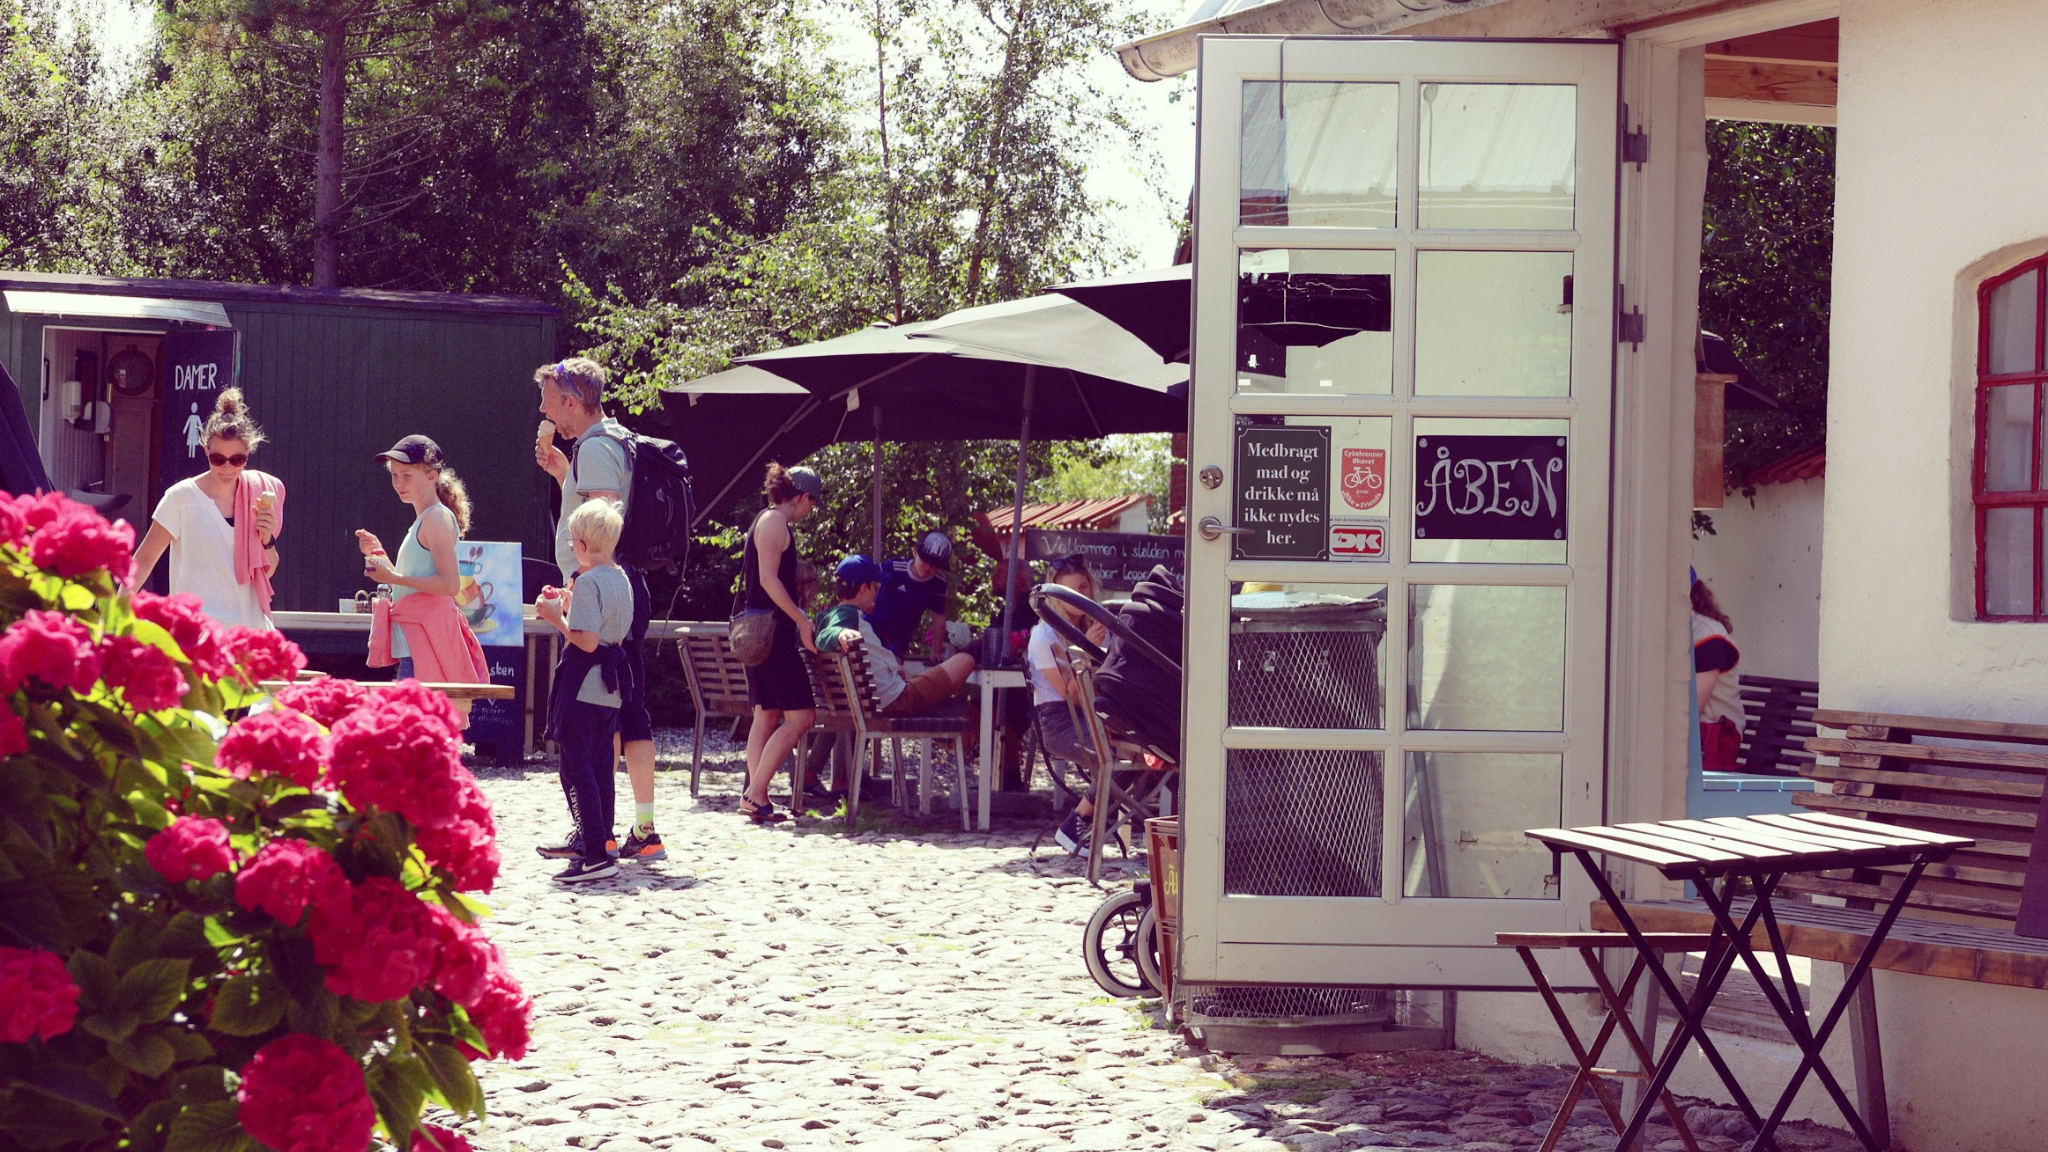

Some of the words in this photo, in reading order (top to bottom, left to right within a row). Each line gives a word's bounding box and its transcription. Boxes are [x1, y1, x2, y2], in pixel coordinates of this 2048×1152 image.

[175, 363, 218, 390] DAMER
[1247, 443, 1319, 462] Medbragt
[1344, 450, 1384, 458] Cykelvenner
[1256, 465, 1288, 479] mad
[1291, 469, 1311, 484] og
[1416, 446, 1563, 518] ÅBEN
[1245, 486, 1294, 501] drikke
[1297, 487, 1320, 501] må
[1244, 508, 1276, 522] ikke
[1279, 509, 1320, 527] nydes
[1266, 530, 1296, 544] her.
[1332, 532, 1382, 552] DK
